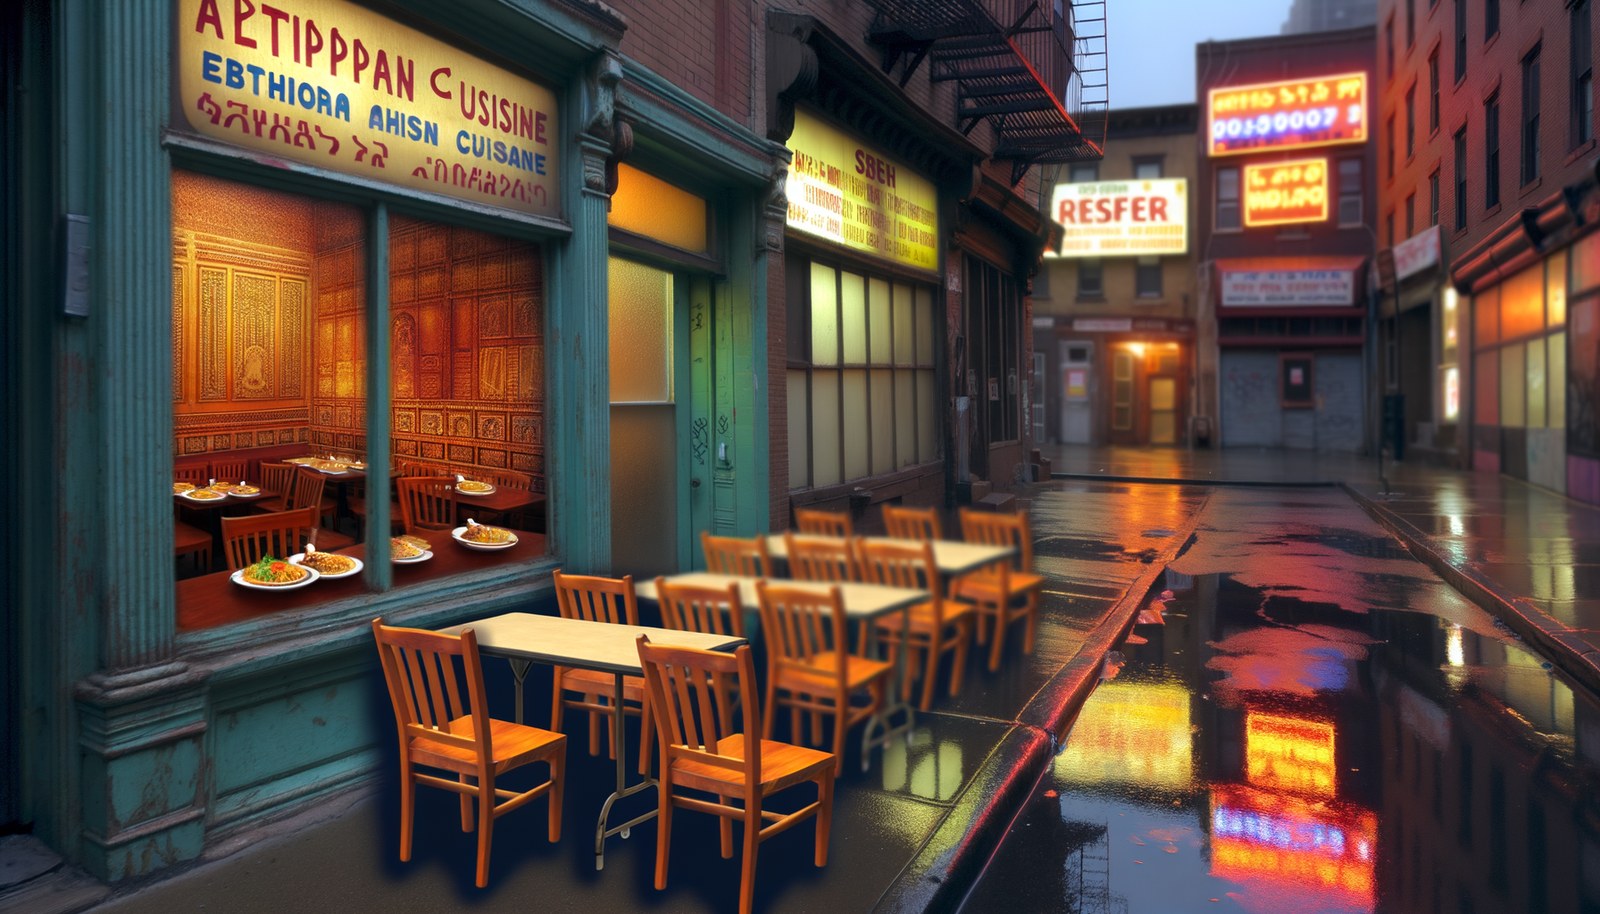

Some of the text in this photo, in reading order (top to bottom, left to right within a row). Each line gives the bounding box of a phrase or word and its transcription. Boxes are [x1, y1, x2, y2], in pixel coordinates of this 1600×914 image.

[368, 105, 438, 147] AHISN
[456, 130, 547, 176] CUISANE
[1059, 196, 1168, 224] RESFER
